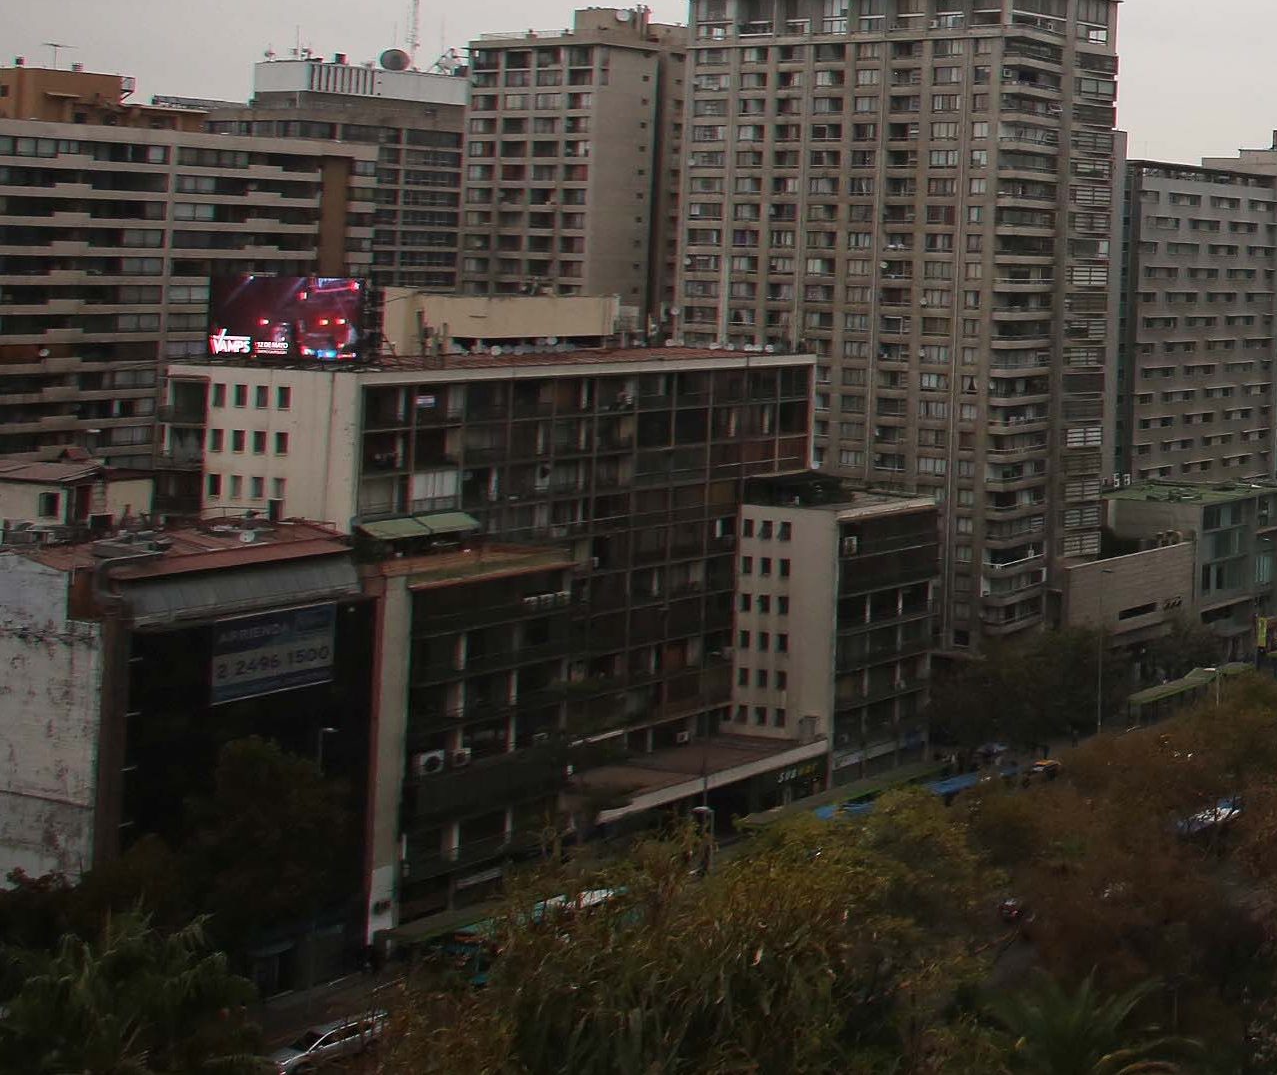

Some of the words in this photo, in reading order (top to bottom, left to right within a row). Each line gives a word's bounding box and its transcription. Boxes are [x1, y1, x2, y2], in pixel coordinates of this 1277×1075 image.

[210, 329, 251, 355] VAMPS
[217, 663, 226, 678] 2
[236, 654, 280, 675] 2496
[288, 645, 330, 665] 1500
